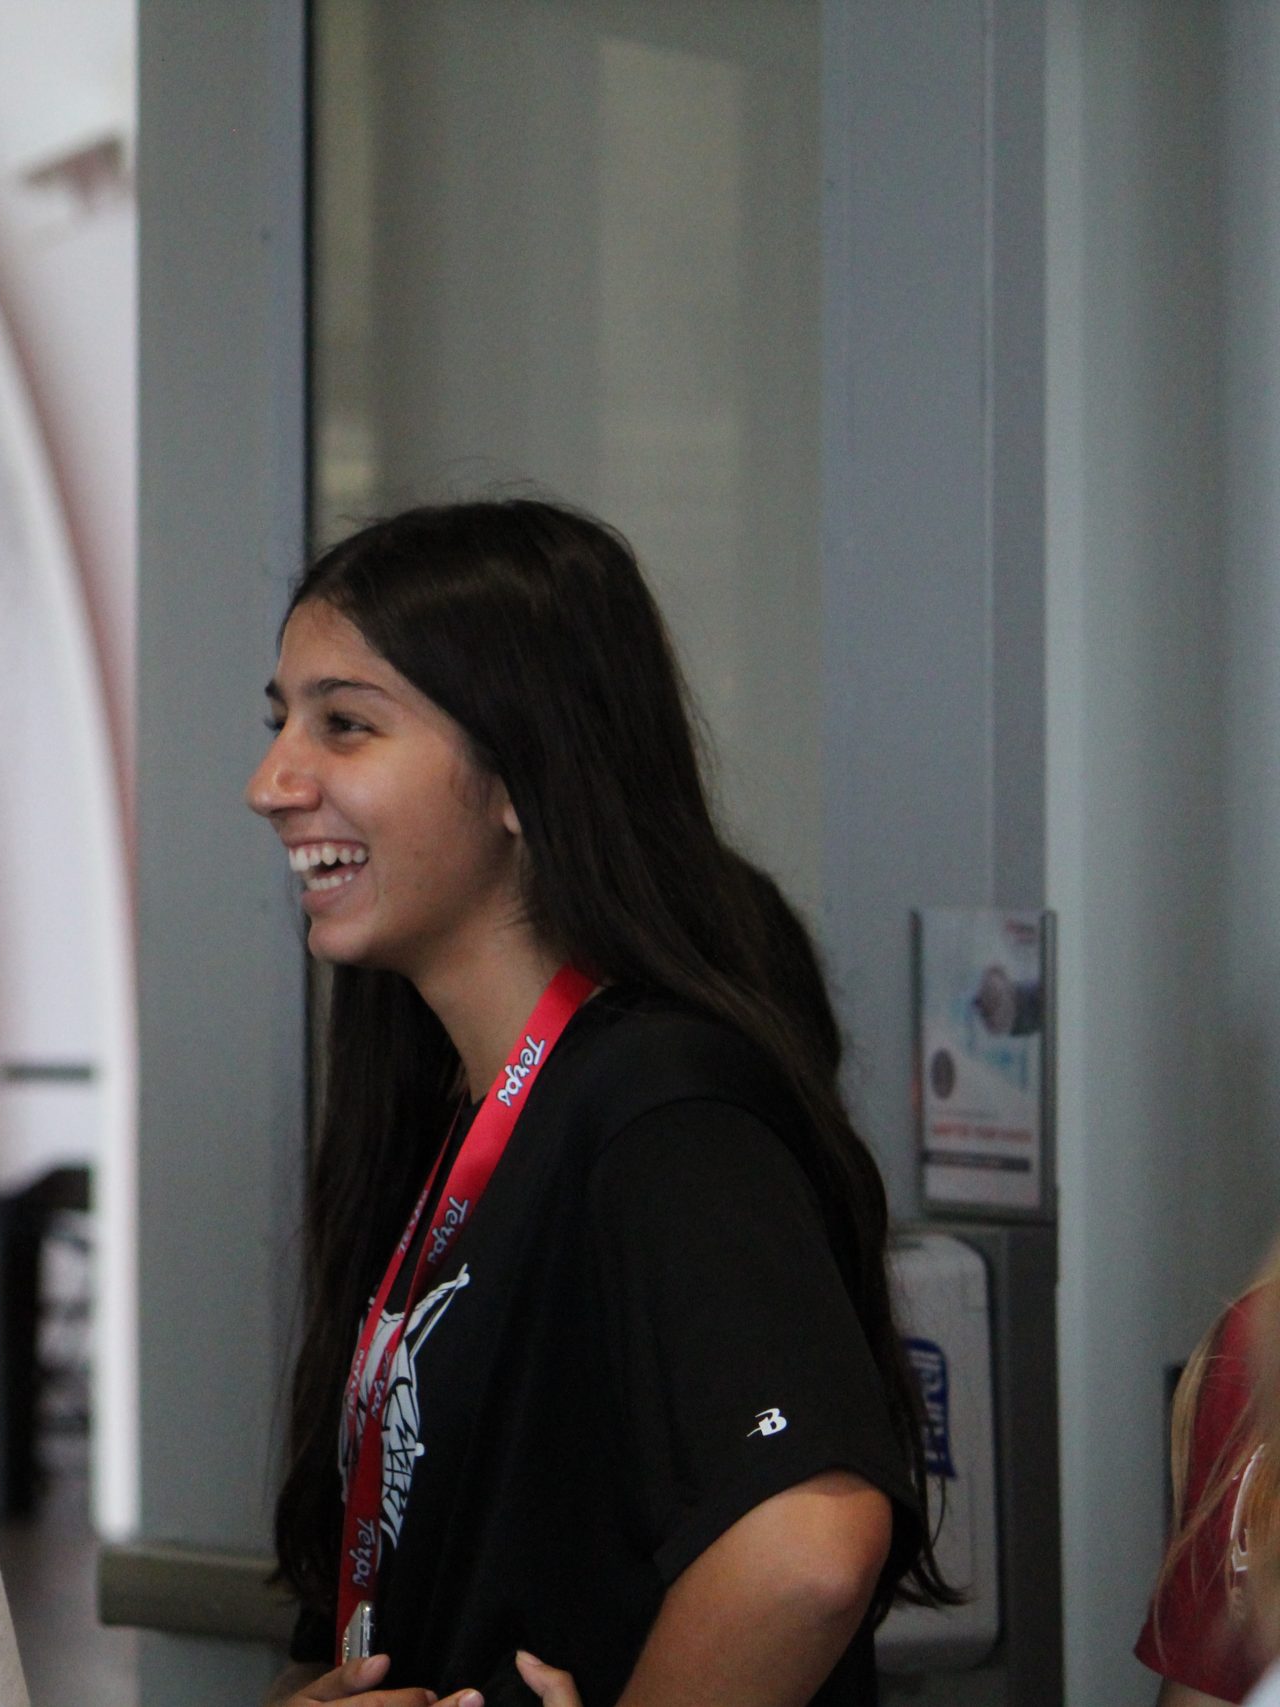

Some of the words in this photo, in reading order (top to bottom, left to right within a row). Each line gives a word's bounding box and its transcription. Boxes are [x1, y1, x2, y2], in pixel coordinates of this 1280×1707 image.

[497, 1034, 546, 1108] Terps
[427, 1196, 469, 1265] Terps
[348, 1516, 377, 1589] Terps
